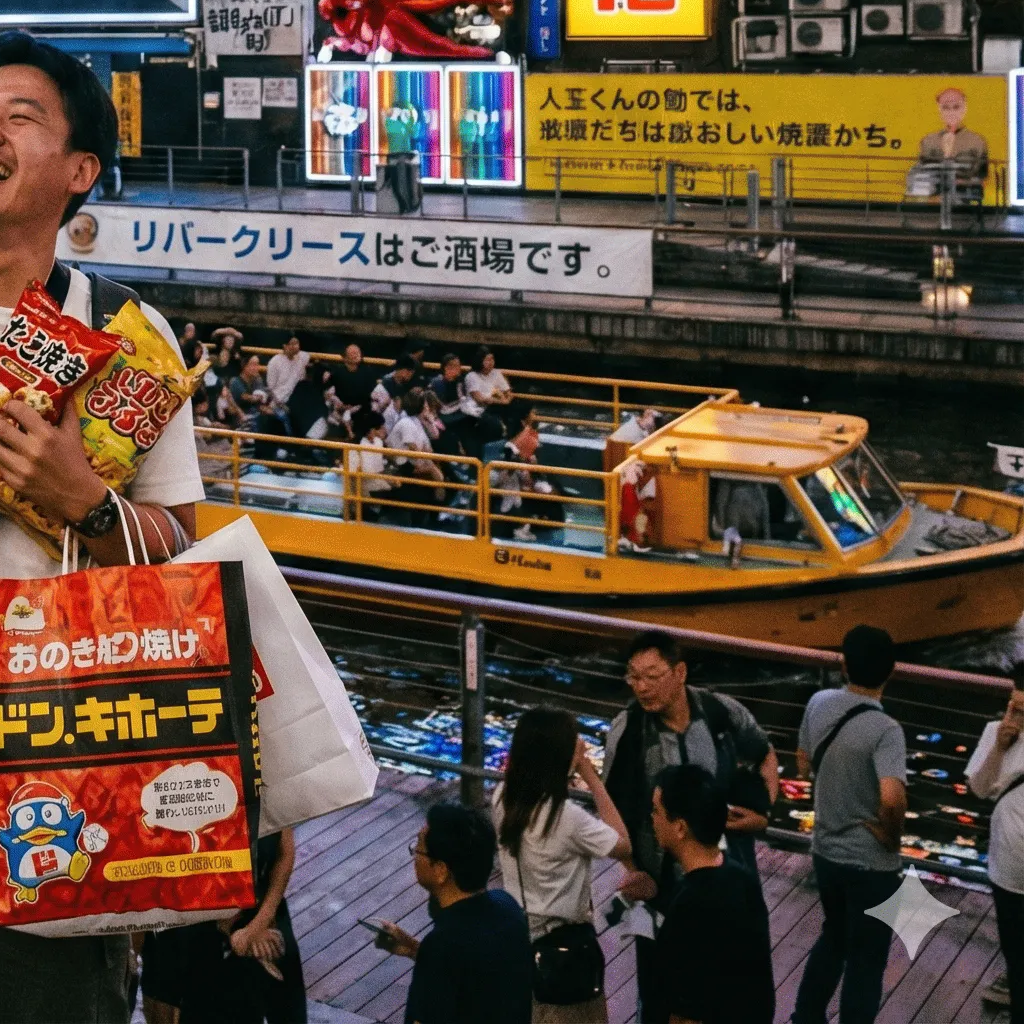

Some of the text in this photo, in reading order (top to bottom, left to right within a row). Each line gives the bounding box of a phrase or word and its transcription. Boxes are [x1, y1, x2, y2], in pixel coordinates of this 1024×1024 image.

[133, 221, 611, 278] リバークリースはご酒場です。
